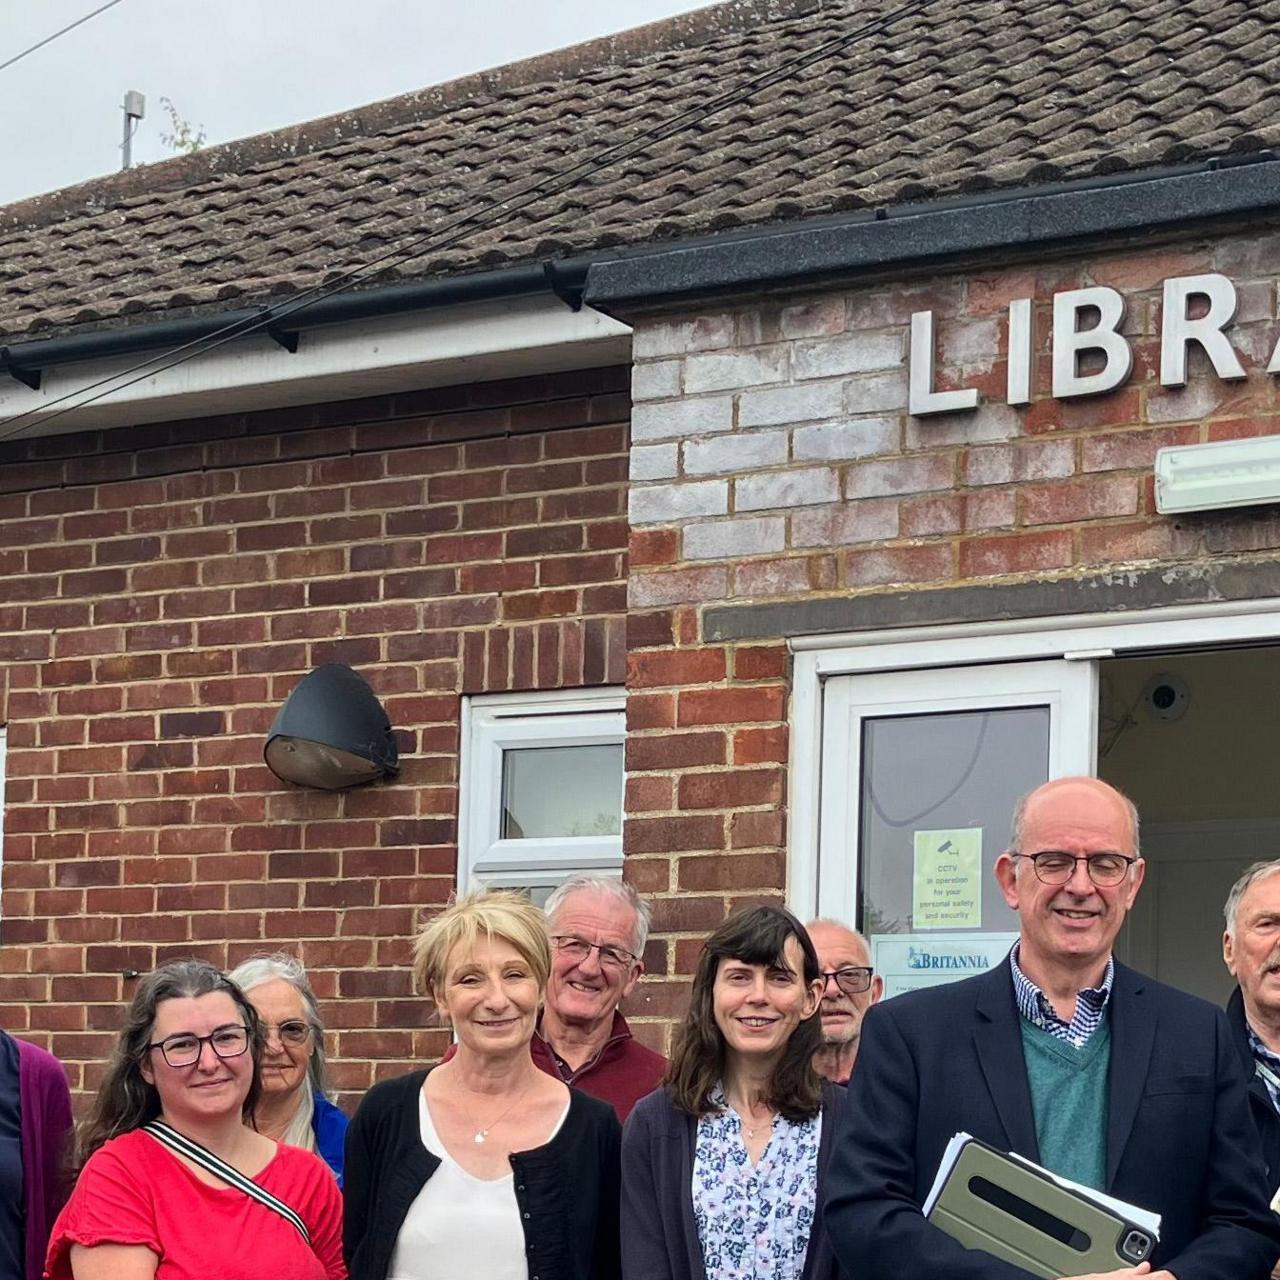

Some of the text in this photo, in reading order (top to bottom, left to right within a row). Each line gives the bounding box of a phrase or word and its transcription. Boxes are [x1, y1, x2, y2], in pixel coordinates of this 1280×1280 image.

[937, 864, 958, 872] CCTV
[935, 877, 969, 885] operation
[945, 889, 961, 897] your
[919, 900, 974, 909] personal safety
[941, 912, 969, 920] security
[922, 953, 990, 969] BRITANNIA
